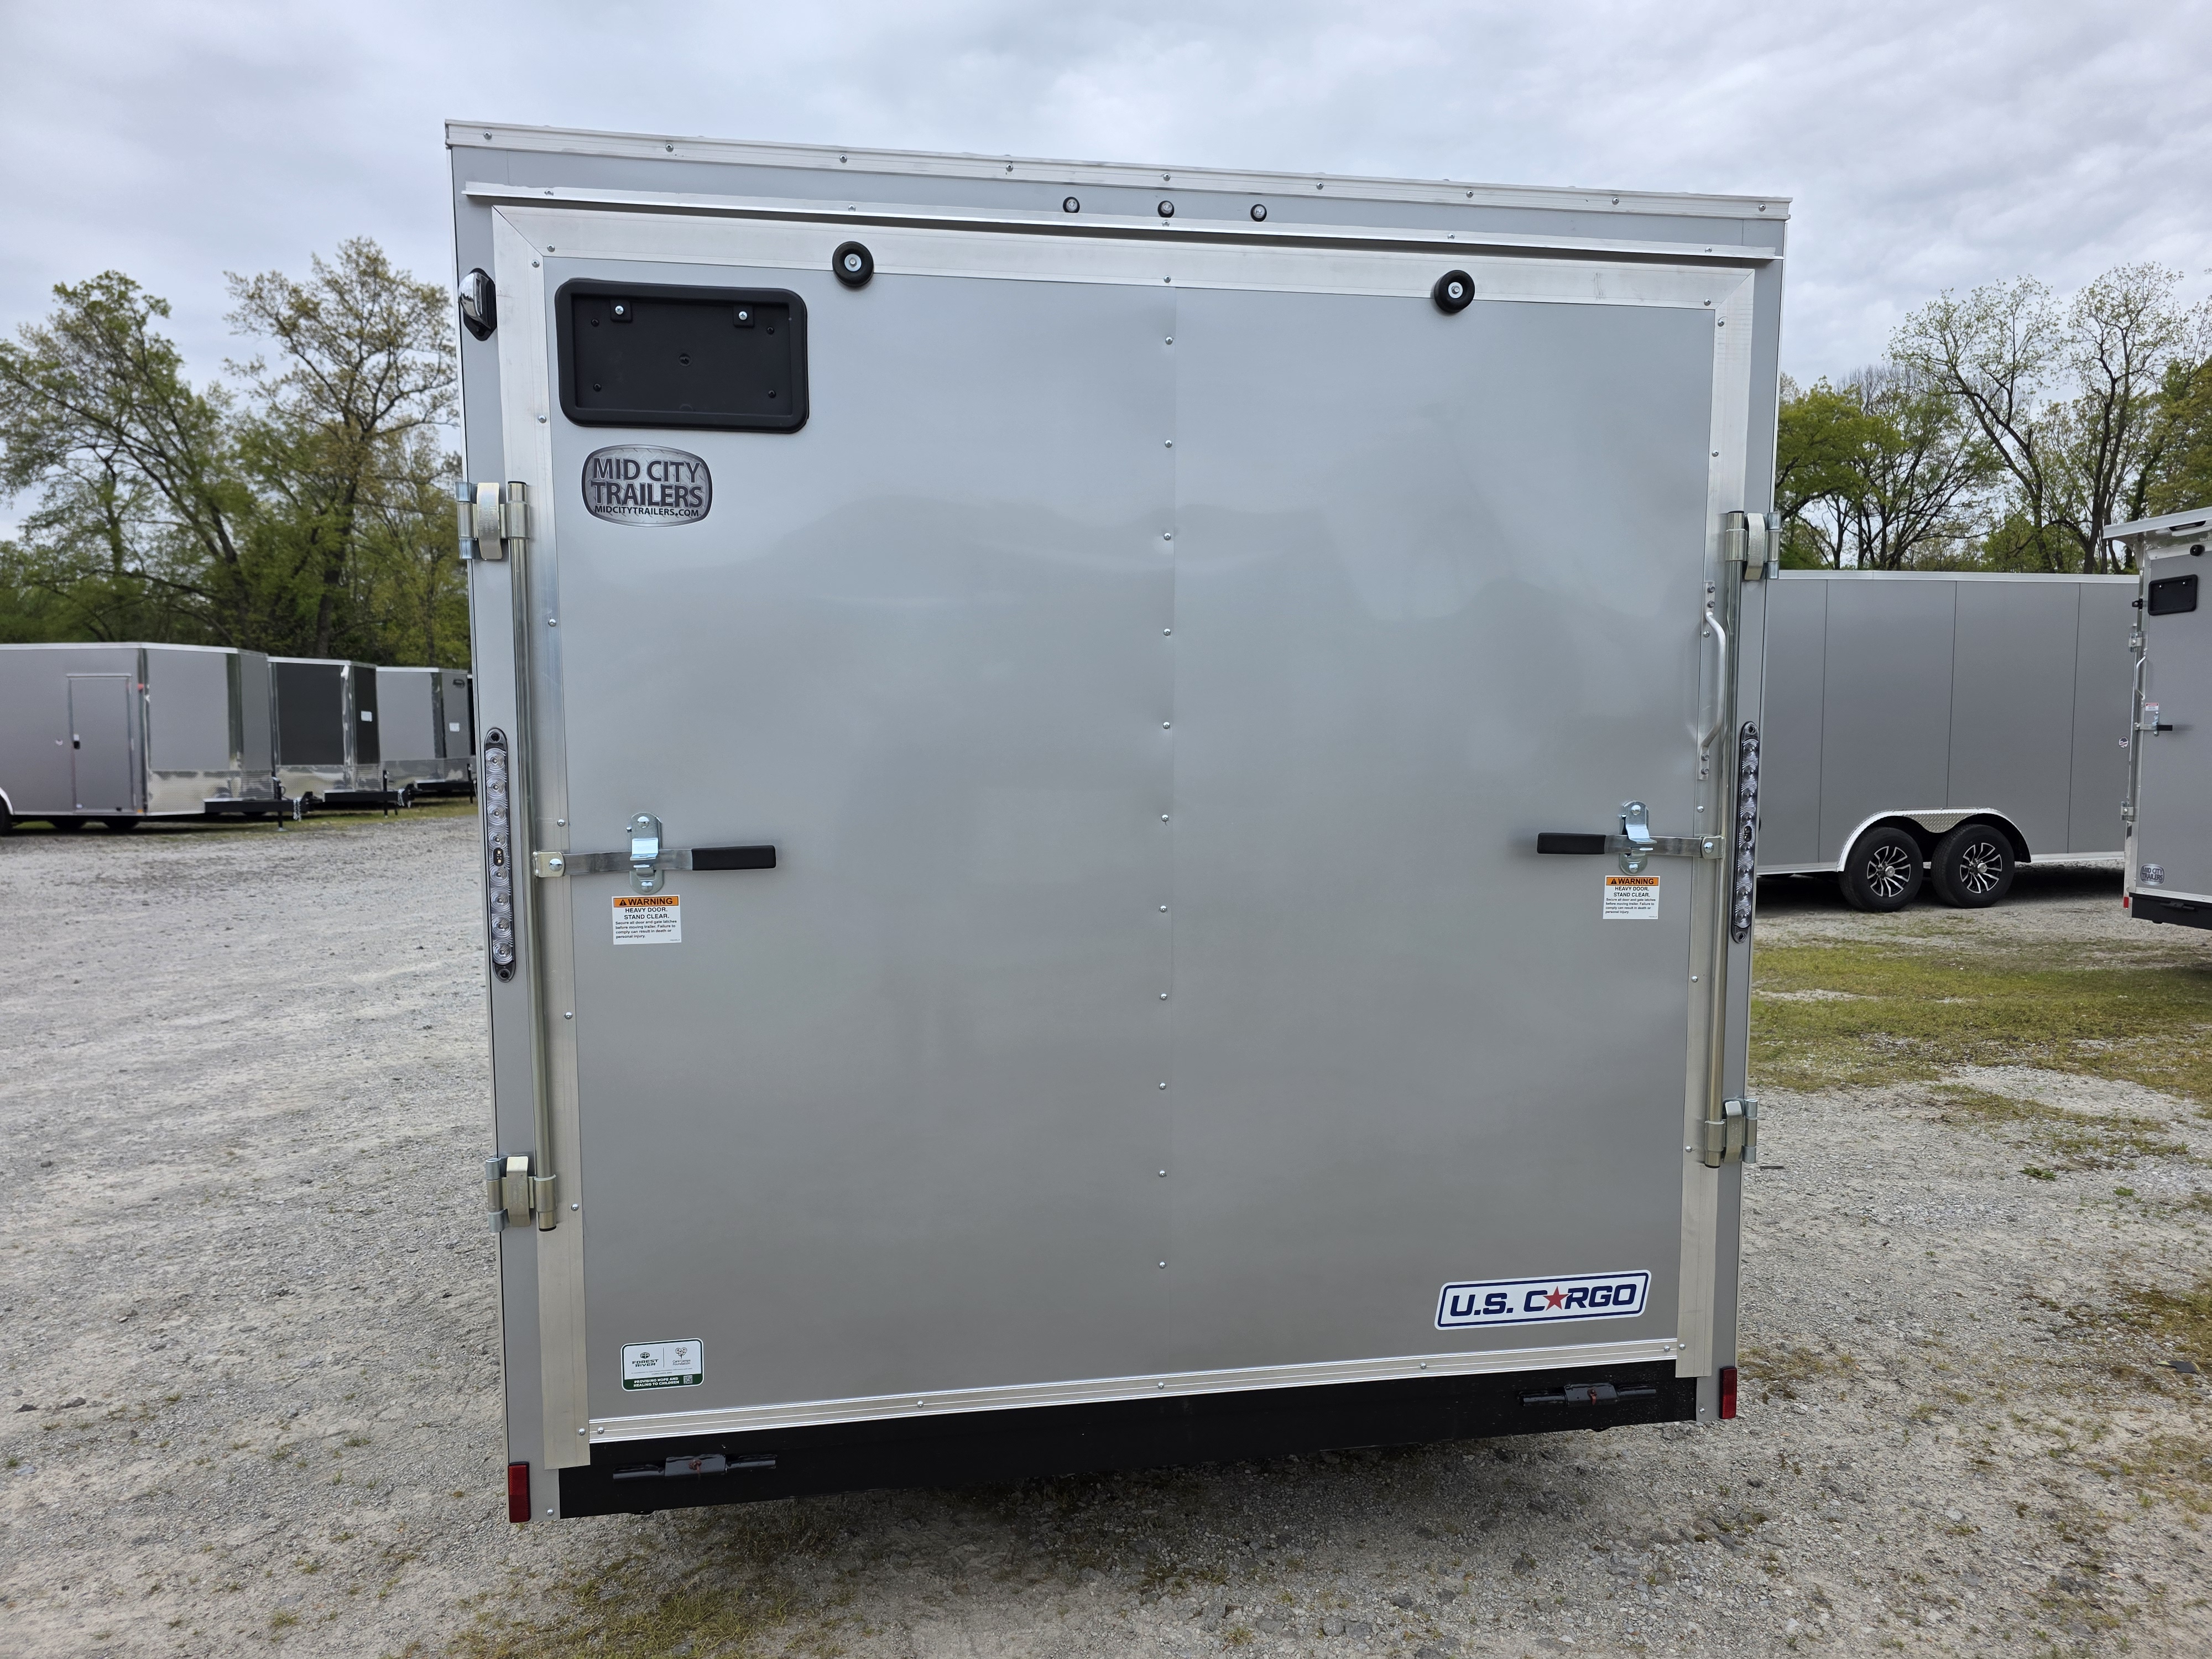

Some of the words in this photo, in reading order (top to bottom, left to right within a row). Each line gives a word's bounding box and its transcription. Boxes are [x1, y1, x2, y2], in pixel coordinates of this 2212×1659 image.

[593, 458, 640, 480] MID
[647, 460, 701, 483] CITY
[591, 481, 703, 508] TRAILERS
[594, 505, 699, 517] MIDCITYTRAILERS.COM
[2142, 872, 2163, 881] TRAILERS
[628, 898, 673, 906] WARNING
[1450, 1292, 1514, 1317] U.S.
